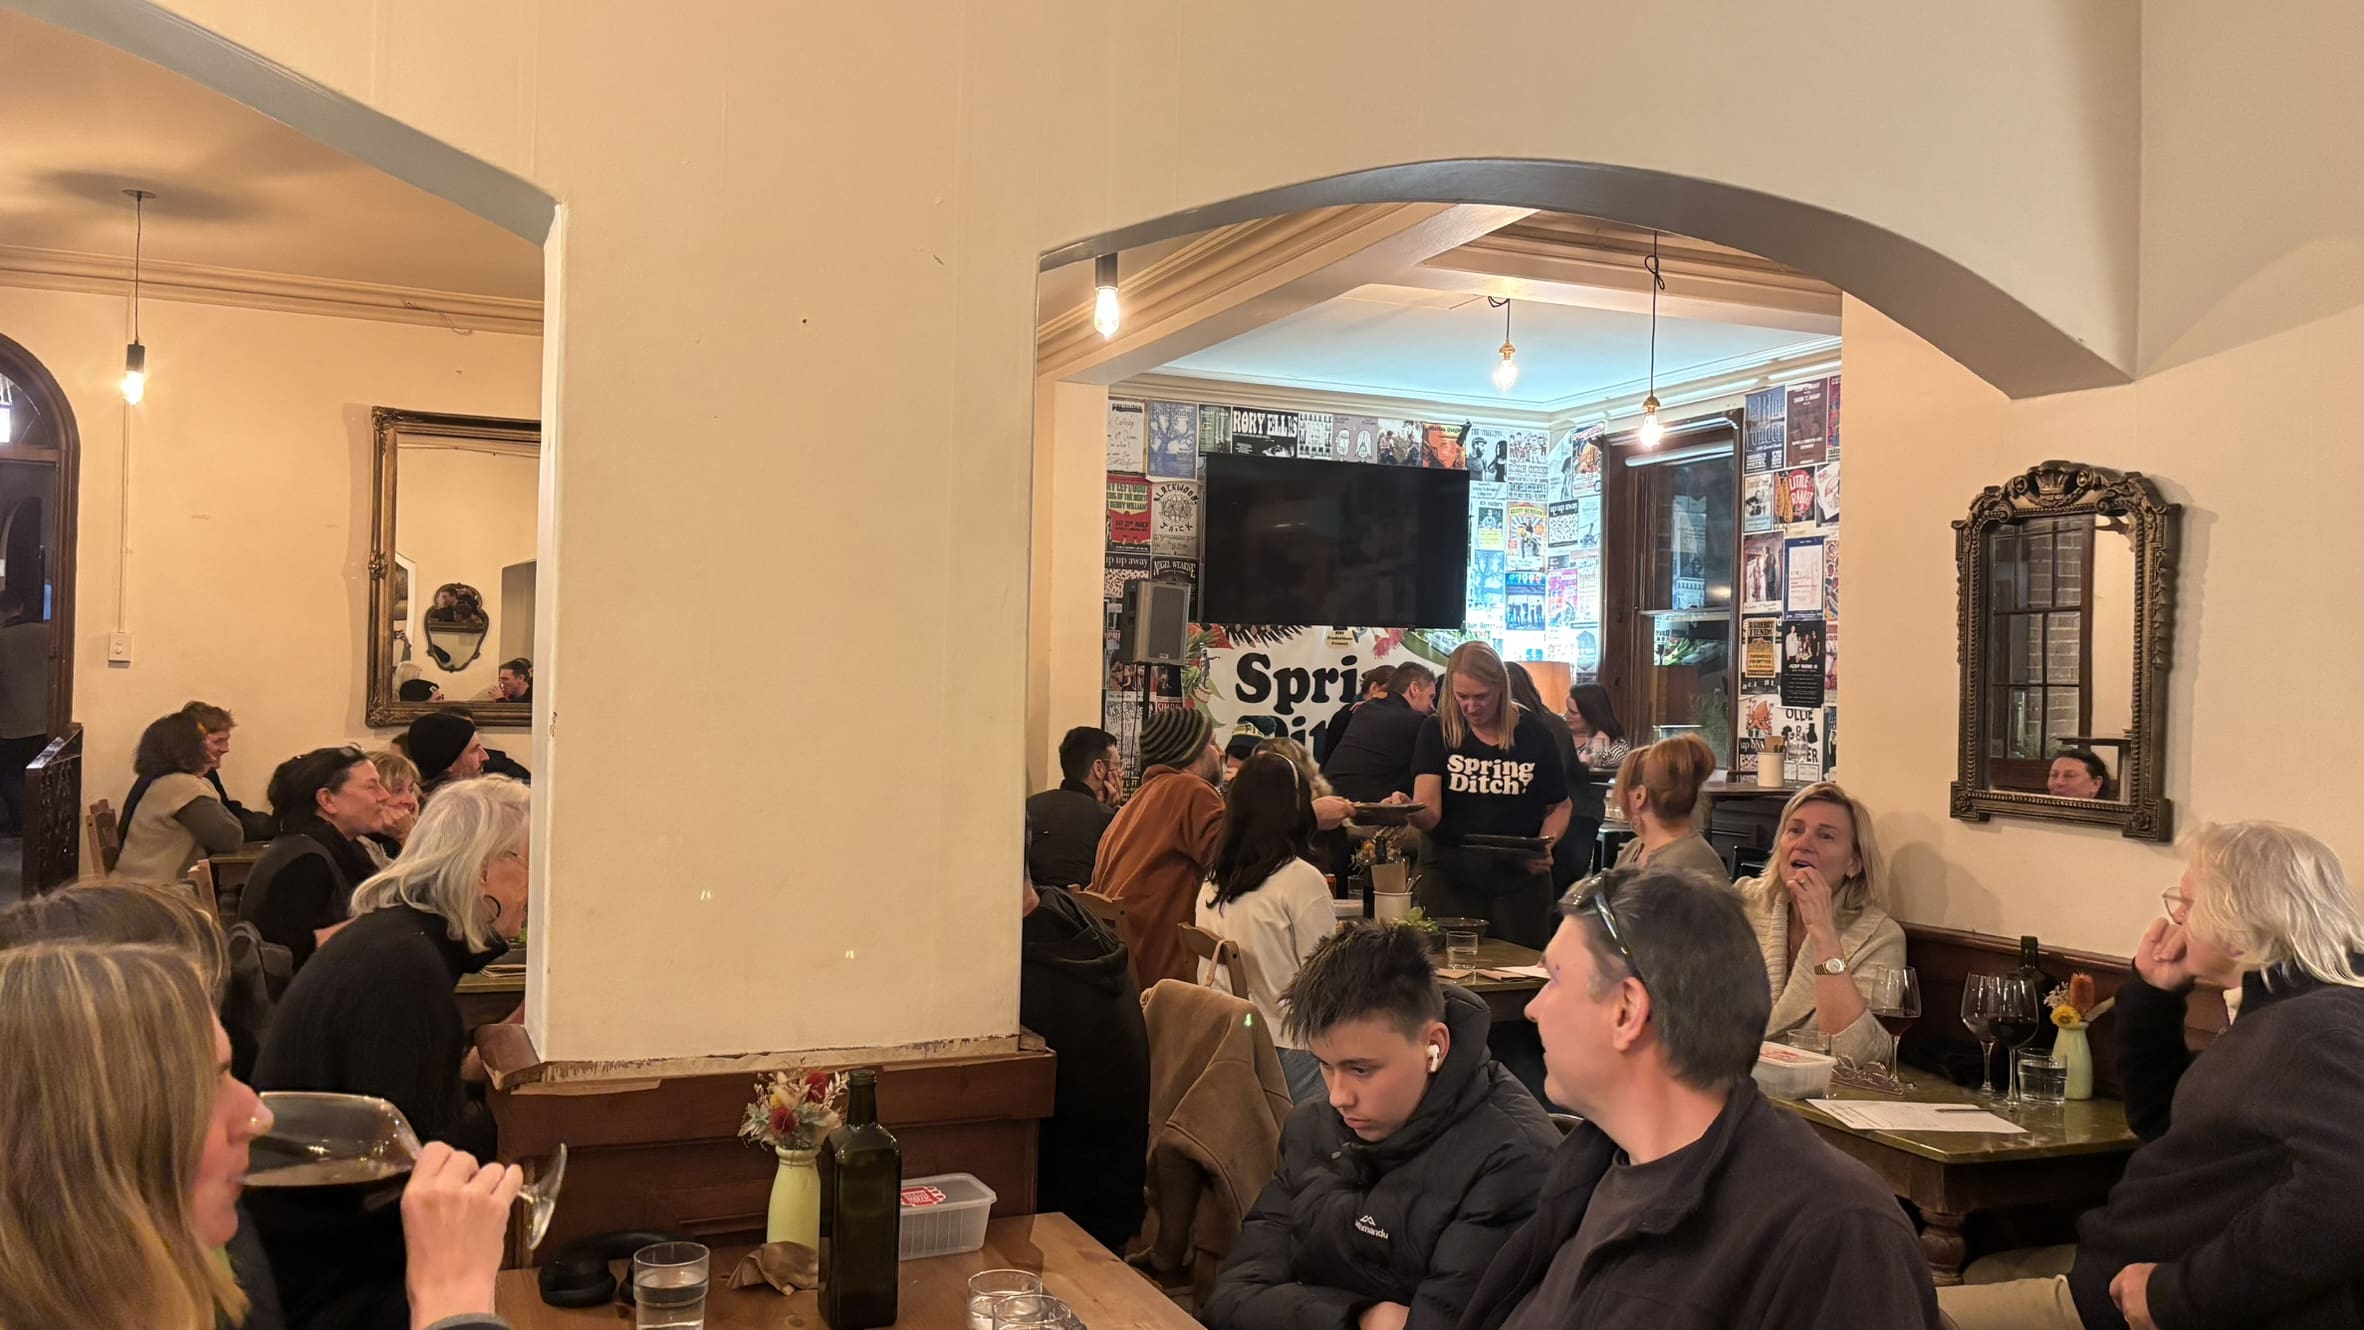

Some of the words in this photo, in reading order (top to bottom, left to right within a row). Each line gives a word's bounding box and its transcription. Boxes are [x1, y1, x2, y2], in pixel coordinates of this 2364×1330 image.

[1233, 410, 1266, 434] RORY
[1267, 414, 1298, 437] ELLIS
[1115, 557, 1127, 567] up
[1128, 558, 1148, 568] away
[1235, 653, 1365, 715] Spri
[1447, 754, 1536, 786] Spring
[1449, 773, 1520, 795] Ditch
